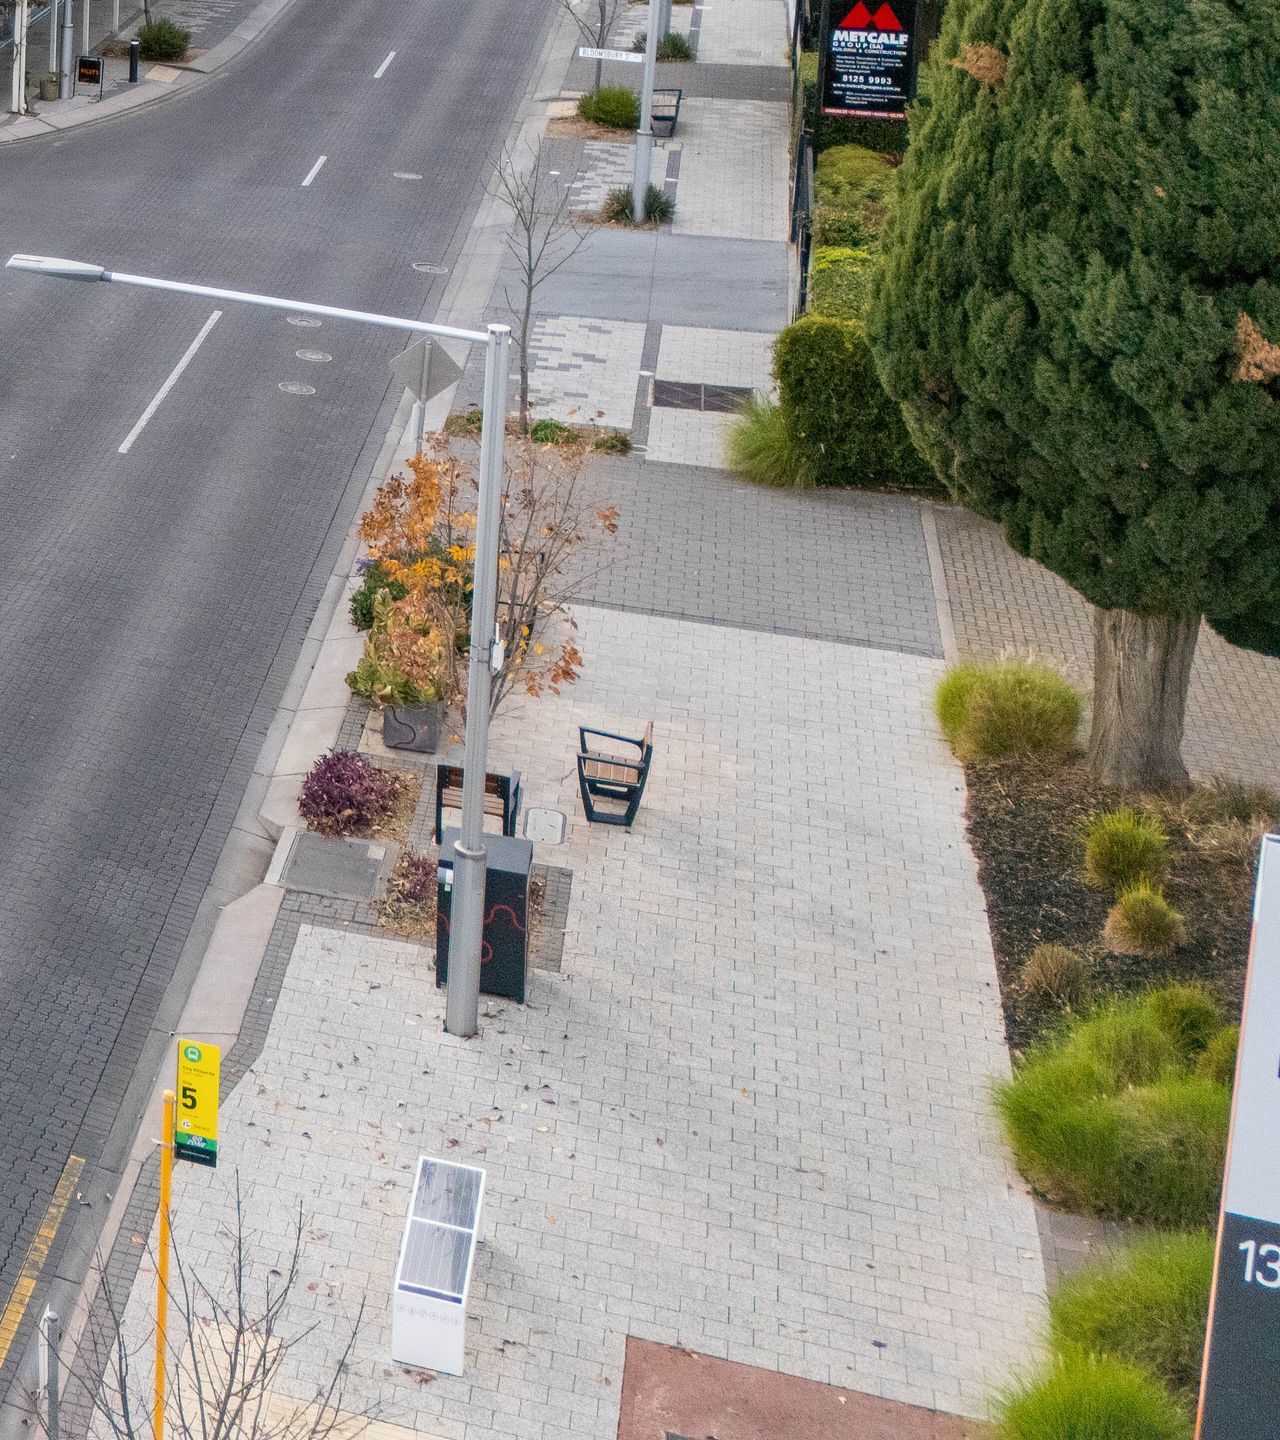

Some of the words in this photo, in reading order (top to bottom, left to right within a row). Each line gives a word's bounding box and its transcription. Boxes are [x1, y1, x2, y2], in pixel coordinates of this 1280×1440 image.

[832, 30, 909, 45] METCALF
[842, 74, 865, 83] 8125
[868, 76, 892, 85] 9993
[181, 1085, 197, 1110] 5
[191, 1134, 204, 1142] GO
[186, 1139, 207, 1149] ZONE
